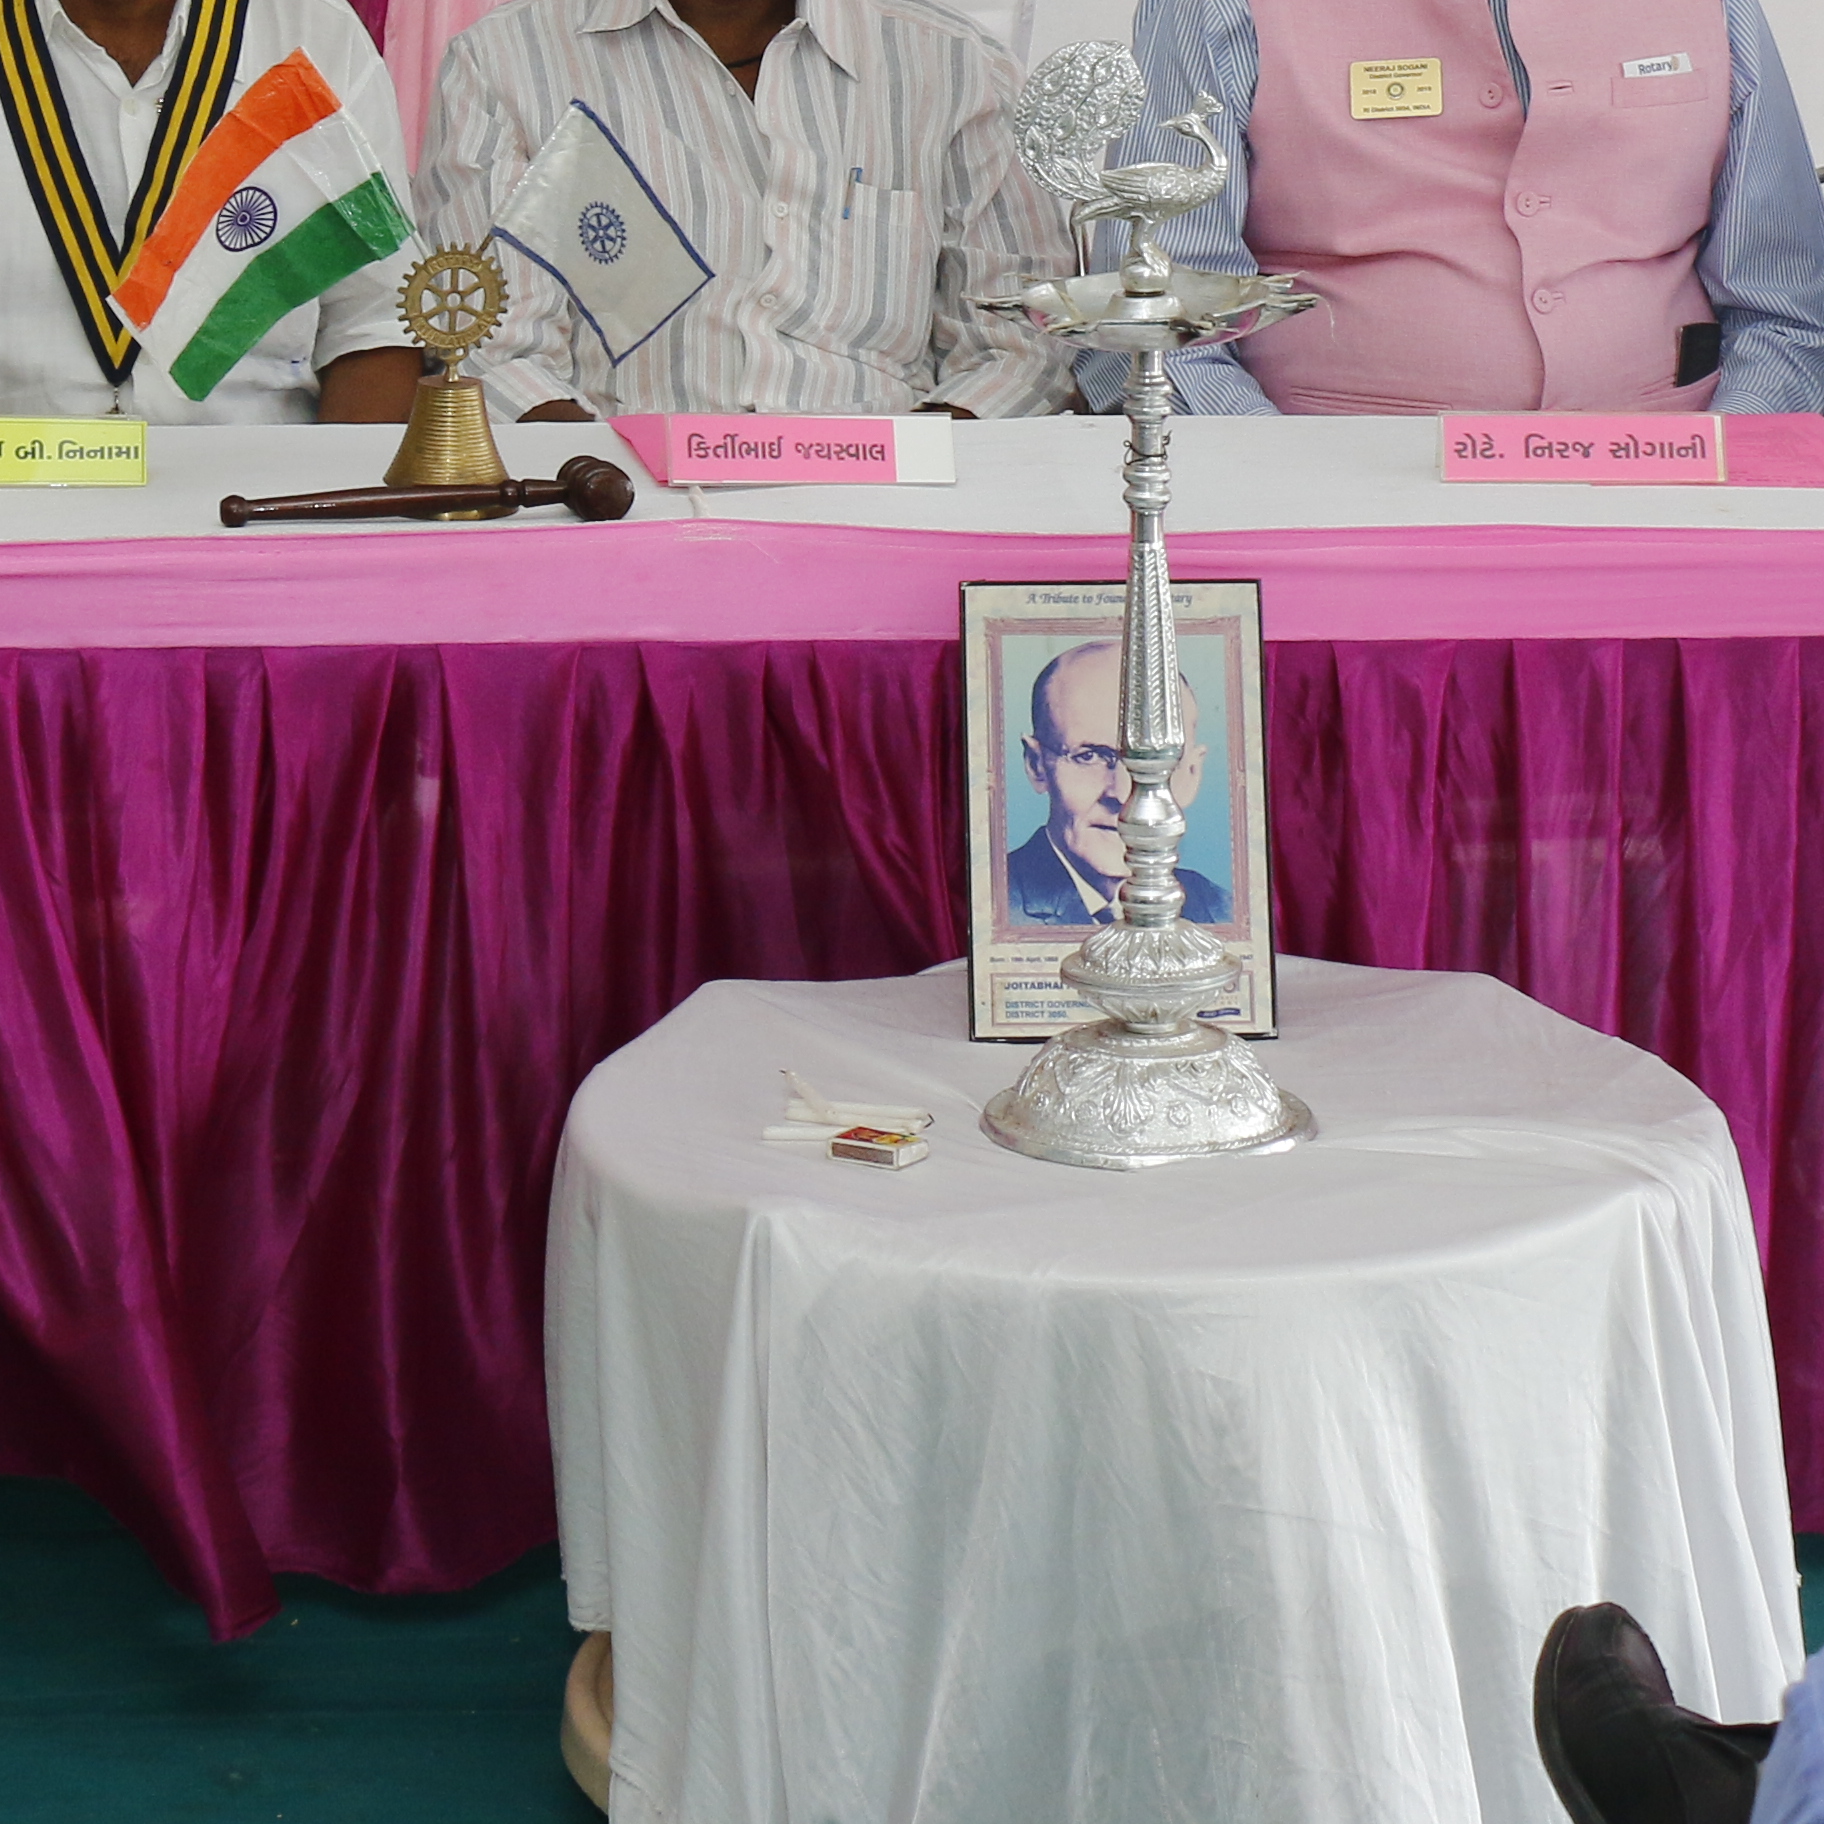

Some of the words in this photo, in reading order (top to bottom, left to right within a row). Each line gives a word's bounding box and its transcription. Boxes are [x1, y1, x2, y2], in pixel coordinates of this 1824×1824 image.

[1363, 64, 1395, 73] NEERAJ
[1397, 63, 1428, 72] SOGANI
[1637, 61, 1673, 76] Rotary
[57, 439, 140, 460] નિનામા
[794, 441, 886, 461] જયસ્વાલ
[1453, 433, 1505, 459] રોટે.
[1524, 433, 1595, 459] નિરજ
[1608, 433, 1707, 460] સોગાની
[1026, 593, 1036, 604] A
[1039, 592, 1079, 604] Tribute
[1082, 594, 1093, 604] to
[1004, 981, 1064, 990] JOITABHAI
[1005, 1001, 1044, 1009] DISTRICT
[1005, 1010, 1044, 1019] DISTRICT
